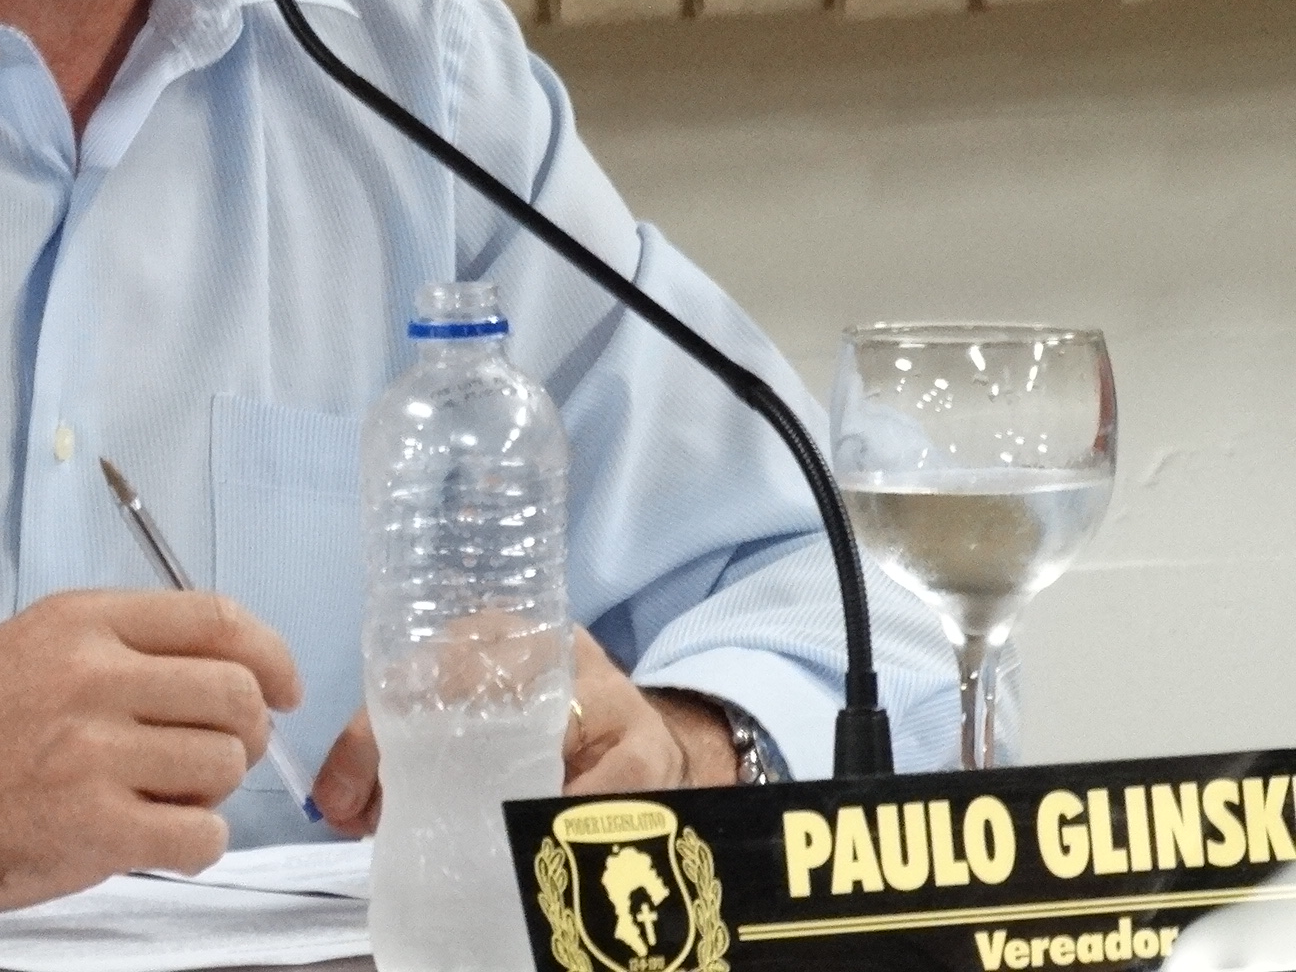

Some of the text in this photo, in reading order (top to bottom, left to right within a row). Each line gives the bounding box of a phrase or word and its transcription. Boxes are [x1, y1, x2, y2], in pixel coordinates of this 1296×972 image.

[564, 817, 600, 836] PODER
[782, 774, 1296, 898] PAULO GLINSK
[974, 916, 1179, 971] Vereador
